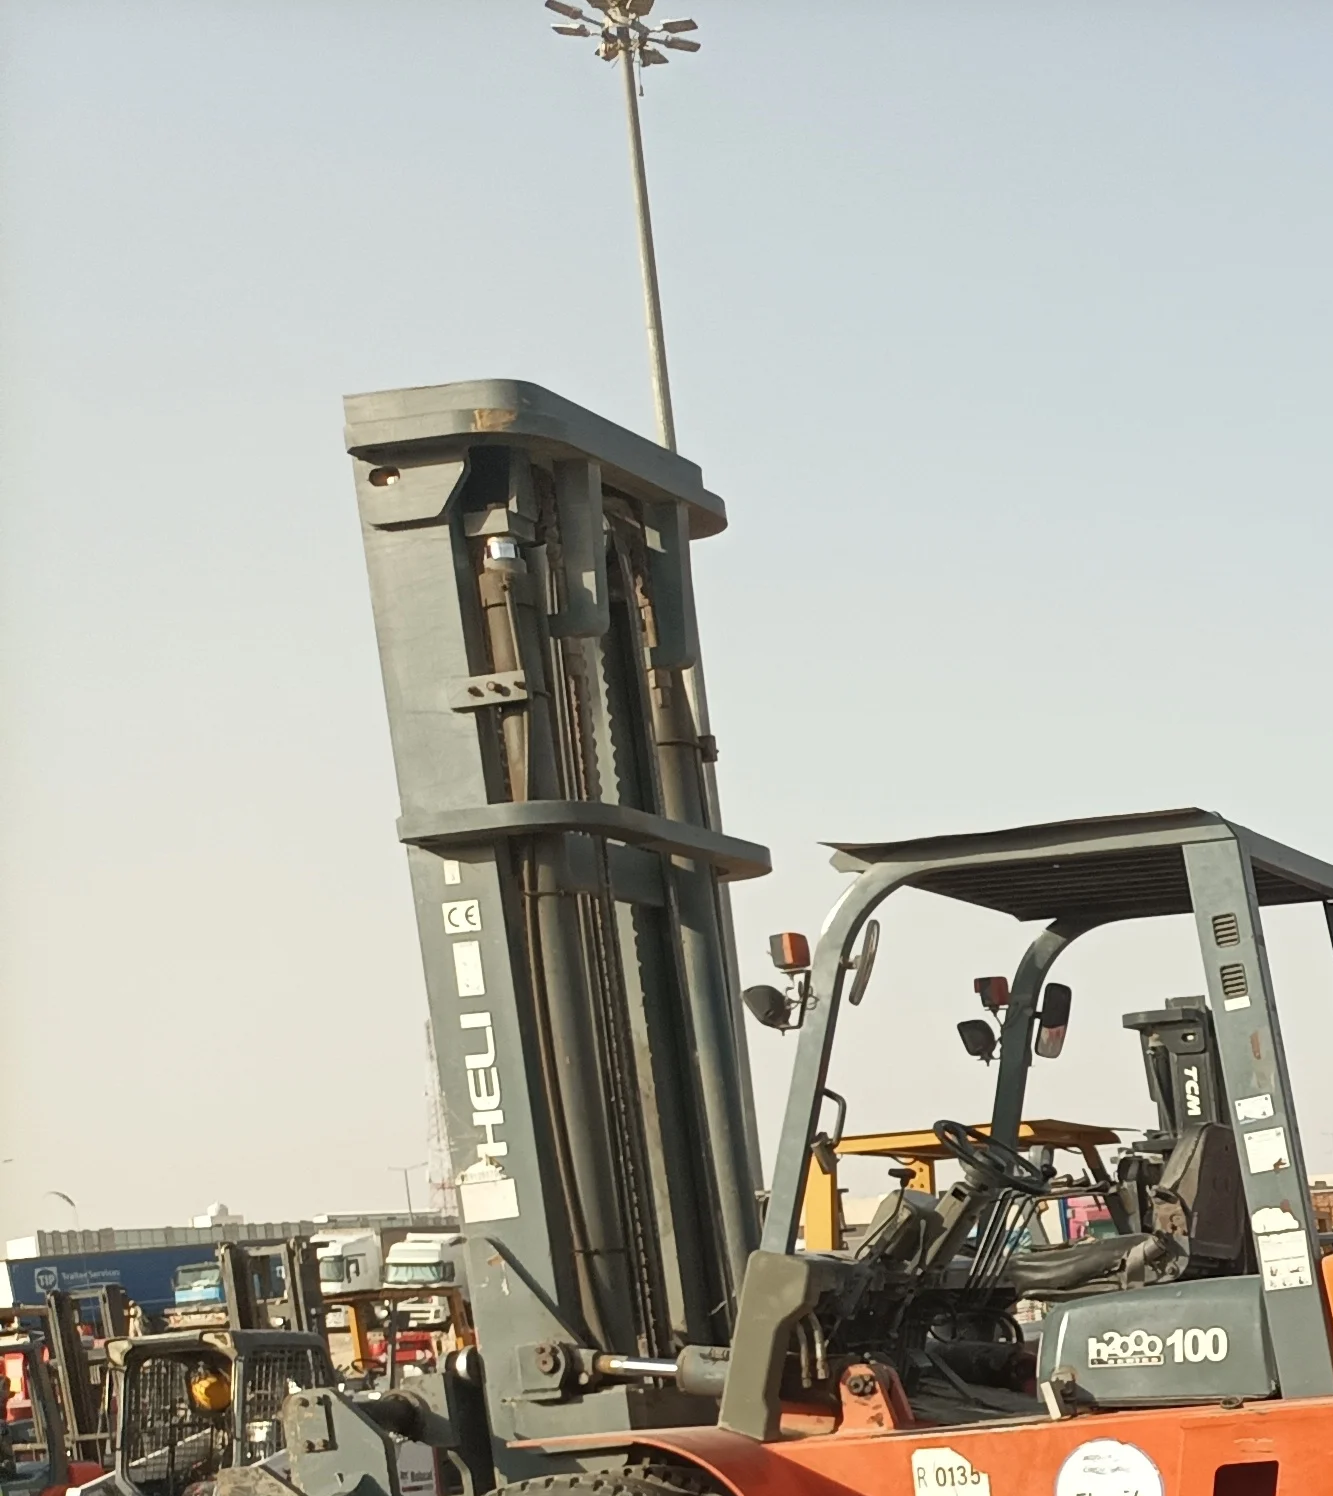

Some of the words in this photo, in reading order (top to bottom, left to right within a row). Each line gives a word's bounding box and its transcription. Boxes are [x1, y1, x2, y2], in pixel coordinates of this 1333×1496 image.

[459, 1011, 508, 1157] HELI
[1183, 1065, 1202, 1117] TCM
[38, 1274, 55, 1287] TIP
[1166, 1327, 1228, 1363] 100
[917, 1466, 928, 1488] R
[935, 1465, 981, 1487] 0135
